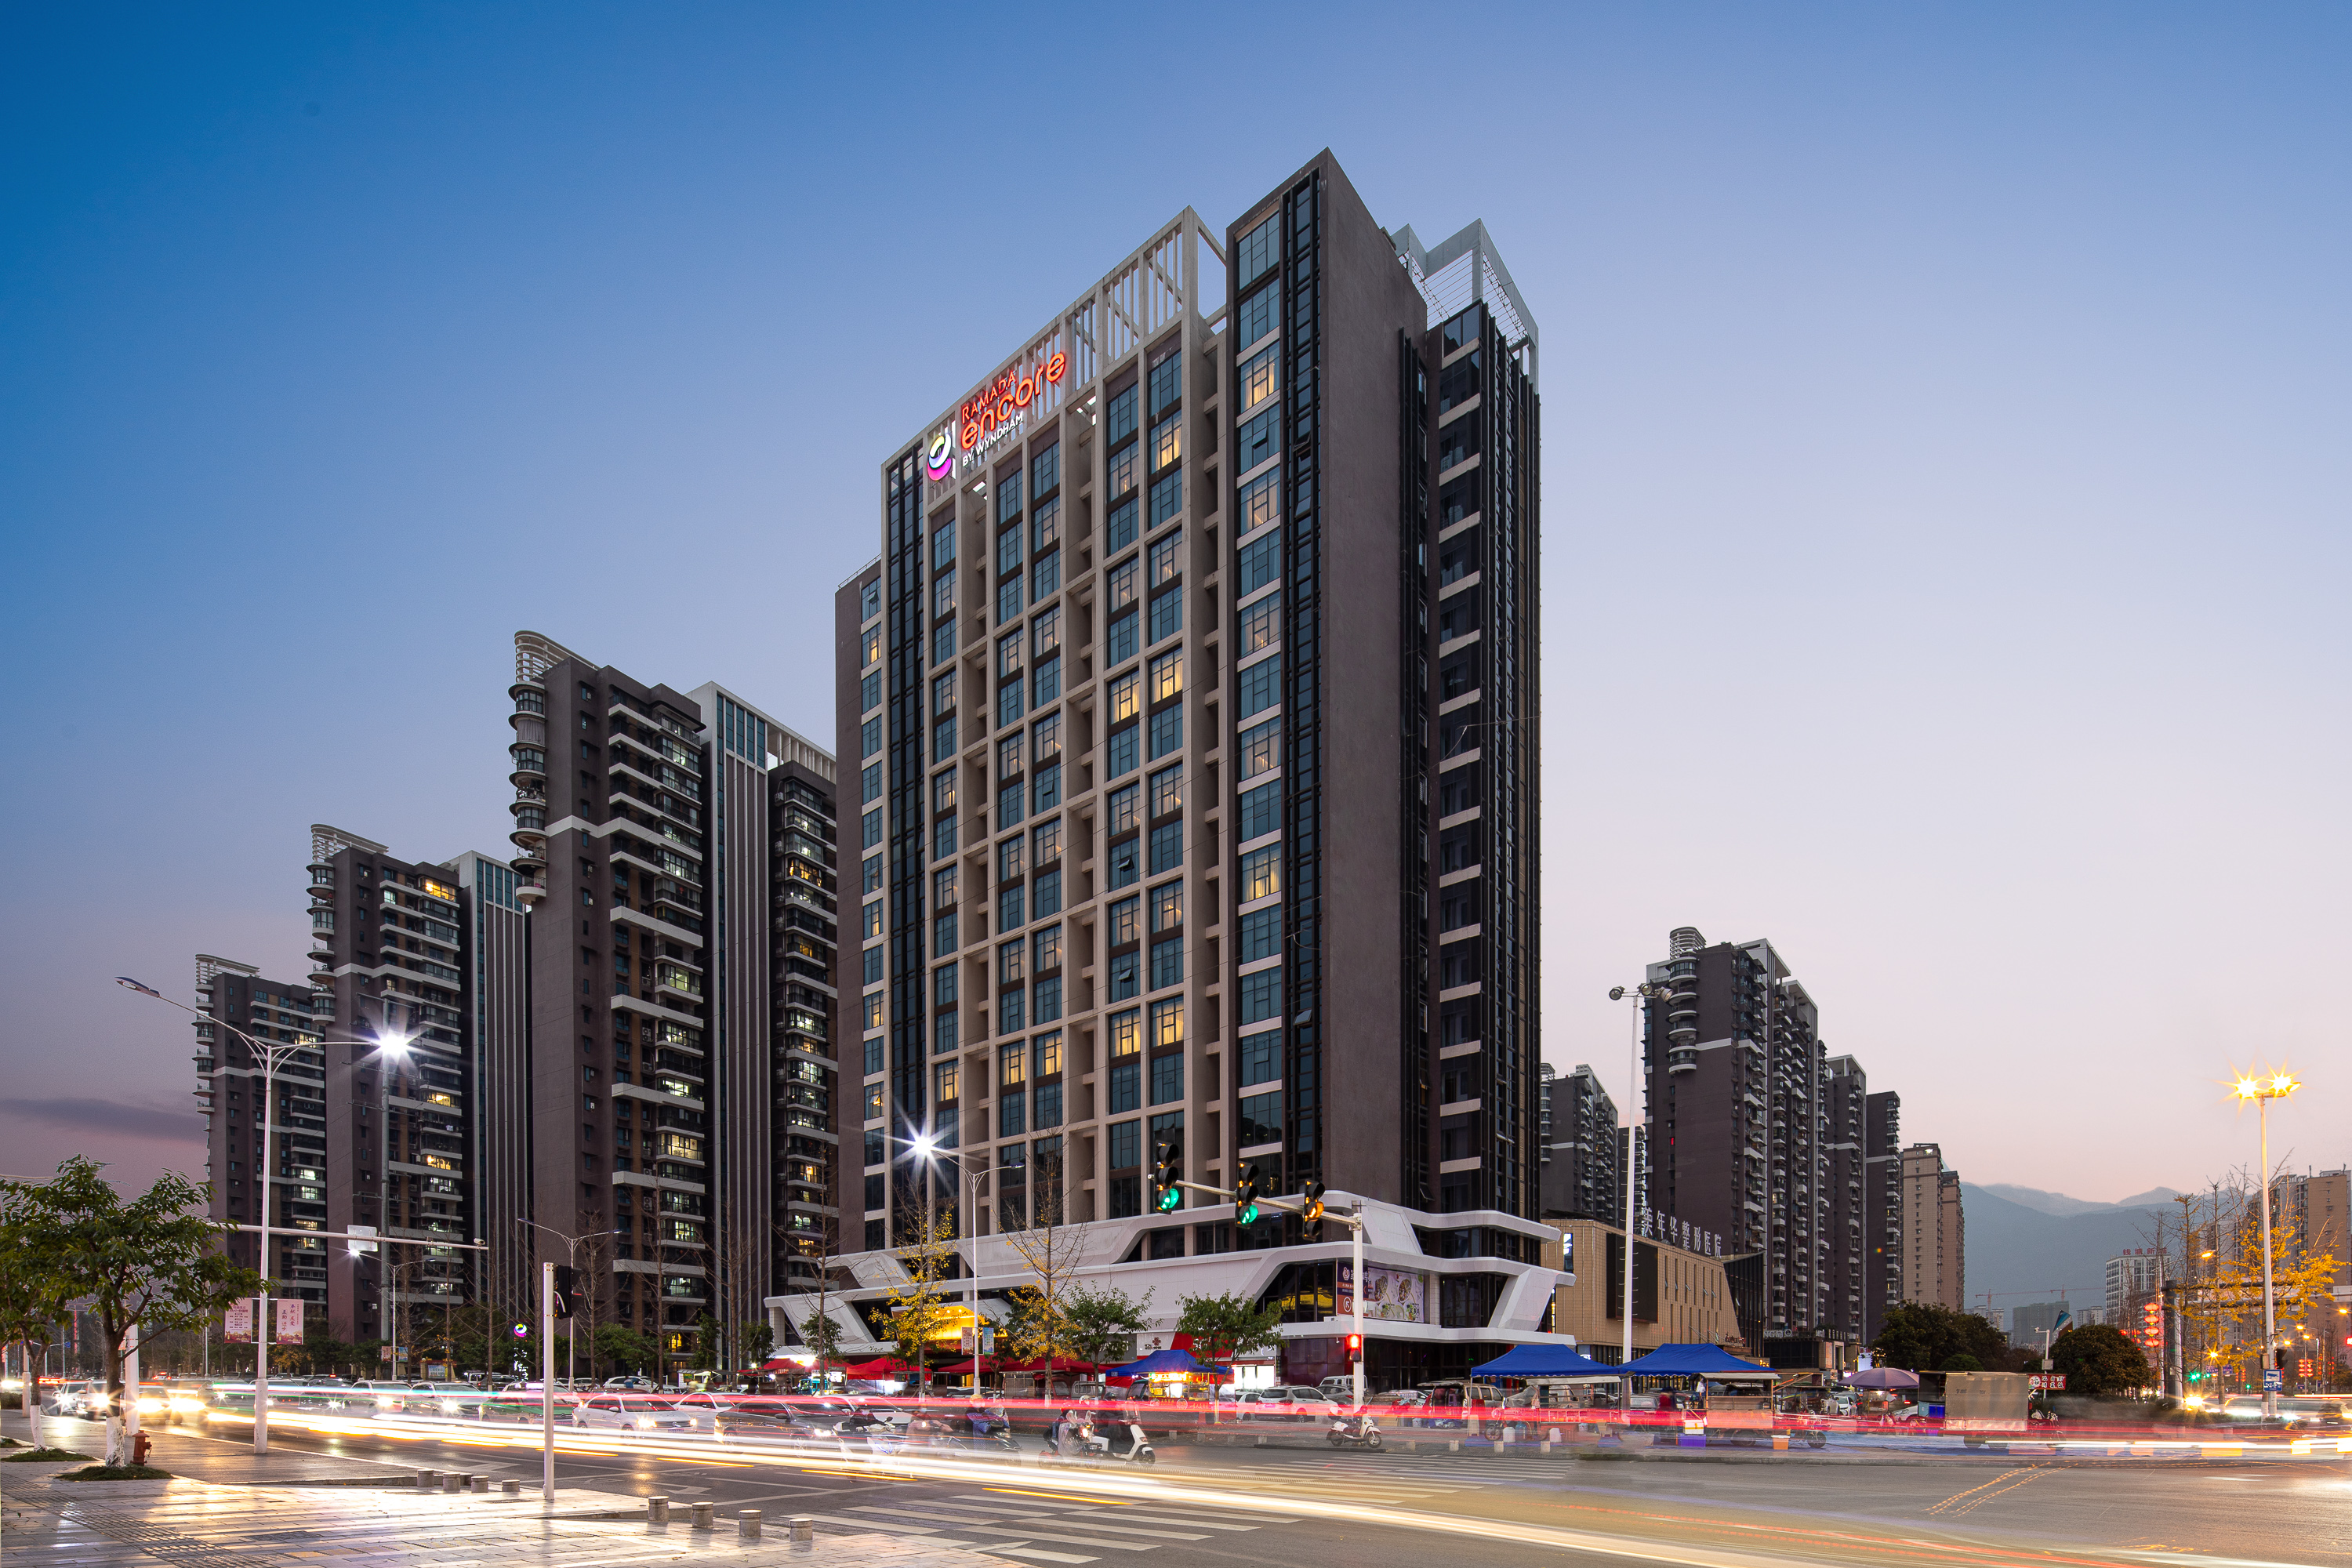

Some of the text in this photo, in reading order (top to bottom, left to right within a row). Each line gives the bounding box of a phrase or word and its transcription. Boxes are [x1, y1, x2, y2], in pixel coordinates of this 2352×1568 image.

[960, 352, 1066, 450] encore
[962, 371, 1017, 423] RAMADA
[962, 410, 1024, 467] BY WYNDHAM
[1641, 1206, 1722, 1259] 美年华整形医院
